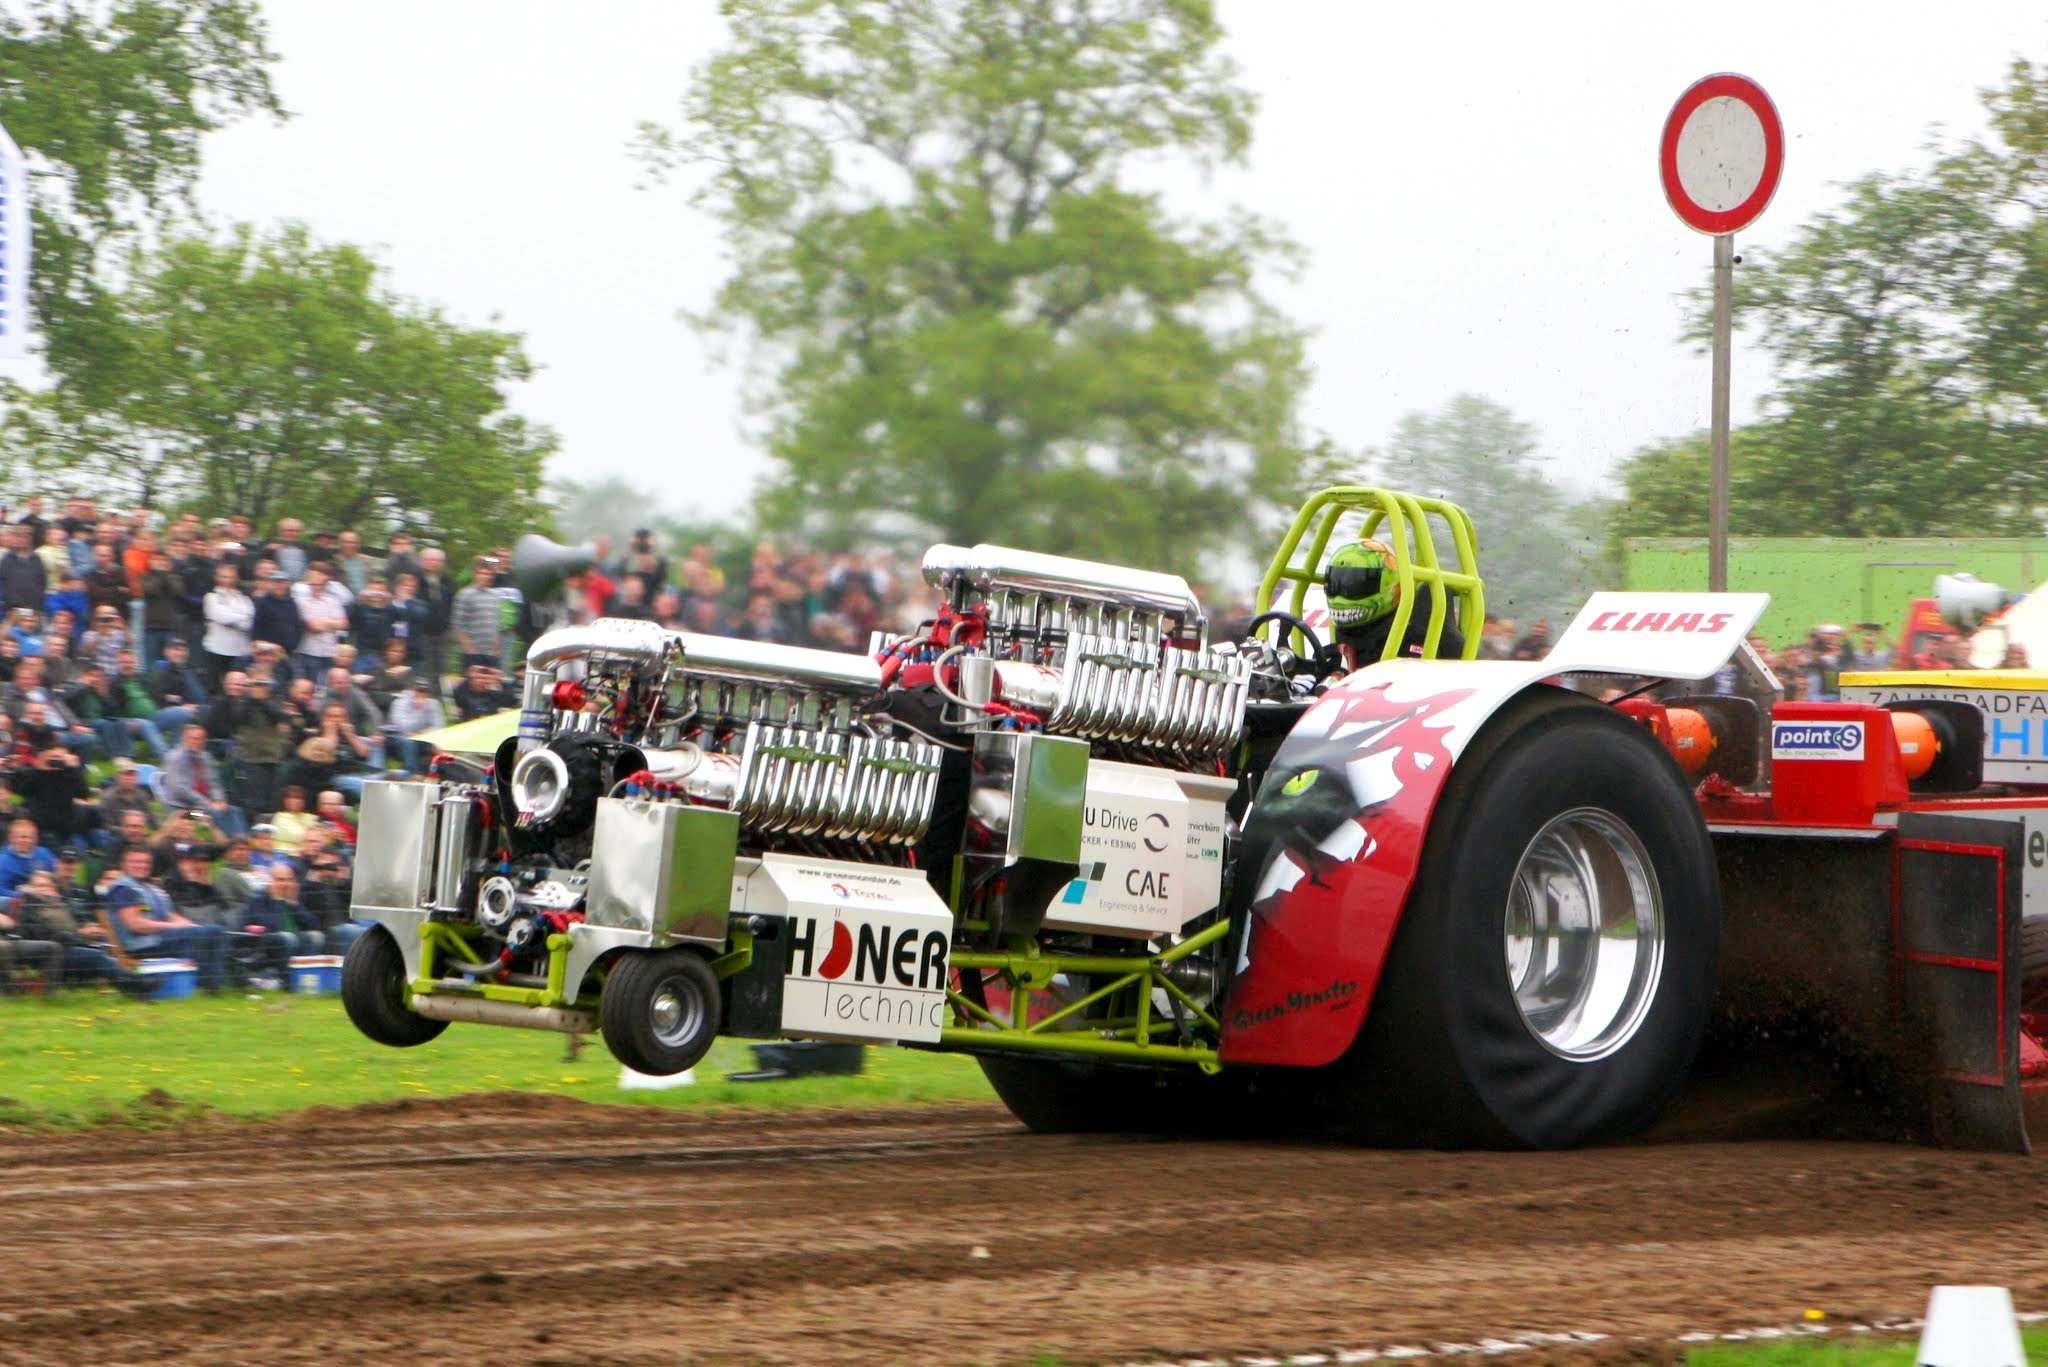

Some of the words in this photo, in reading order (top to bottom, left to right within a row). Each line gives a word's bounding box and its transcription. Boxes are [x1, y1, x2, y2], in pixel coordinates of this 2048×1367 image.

[1586, 611, 1735, 633] CLAAS
[1780, 729, 1831, 746] point
[1842, 728, 1858, 747] S
[1992, 718, 2048, 756] H
[1085, 807, 1096, 826] U
[1101, 809, 1138, 832] Drive
[1110, 839, 1137, 850] ESSING
[851, 888, 896, 901] TOTAL
[1125, 868, 1170, 899] CAE
[785, 908, 949, 990] HÖNER
[824, 982, 942, 1028] Technic
[1233, 1007, 1285, 1028] Green
[1287, 979, 1359, 1011] Monster
